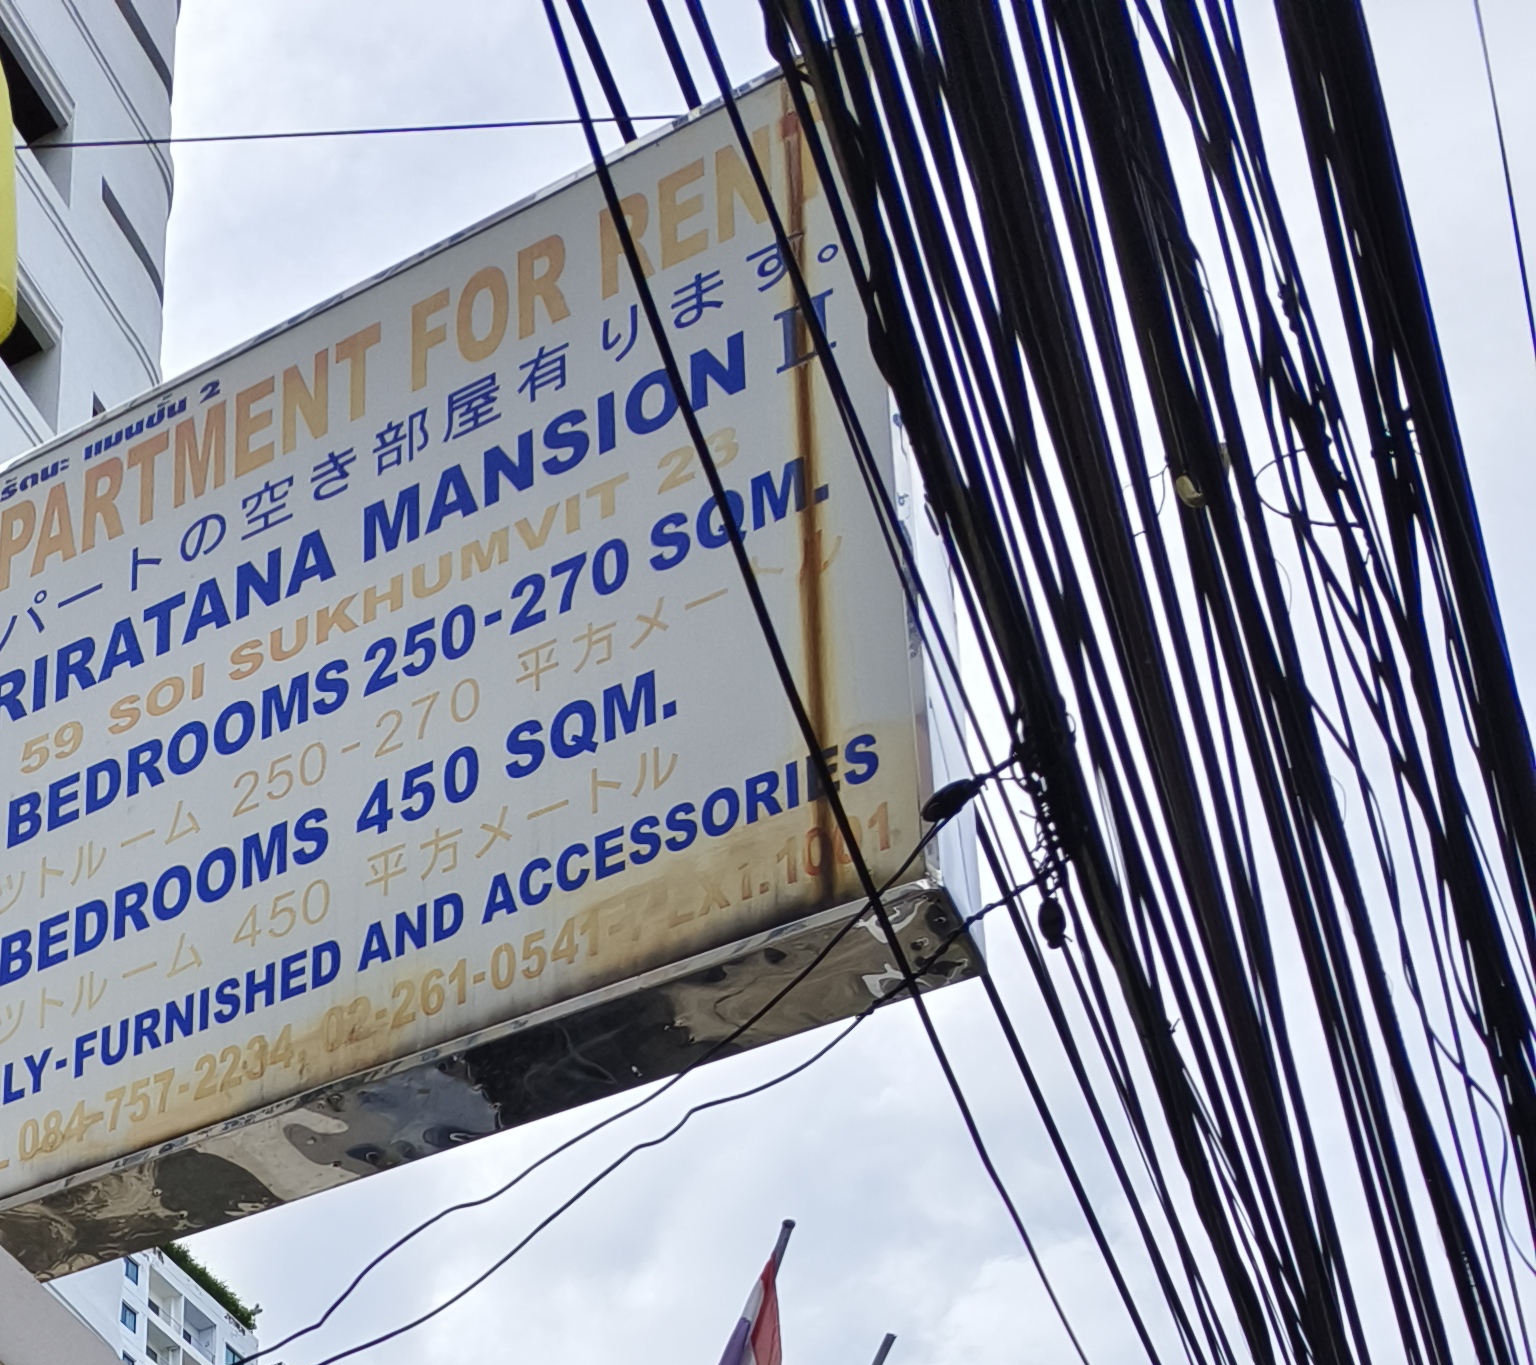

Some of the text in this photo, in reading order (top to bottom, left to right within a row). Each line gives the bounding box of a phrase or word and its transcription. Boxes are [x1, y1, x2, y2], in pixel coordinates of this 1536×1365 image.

[199, 379, 221, 404] 2
[411, 234, 571, 392] FOR
[363, 331, 746, 563] MANSION
[6, 658, 349, 849] BEDROOMS
[363, 538, 629, 697] 250-270
[649, 456, 829, 571] SQM.
[20, 427, 740, 775] 59 SOI SUKHUMVIT 23
[0, 808, 329, 987] BEDROOMS
[356, 746, 478, 835] 450
[505, 669, 678, 779] SQM.
[233, 879, 331, 949] 450
[365, 746, 679, 897] 平方メートル
[357, 892, 464, 973] AND
[481, 734, 879, 925] ACCESSORIES
